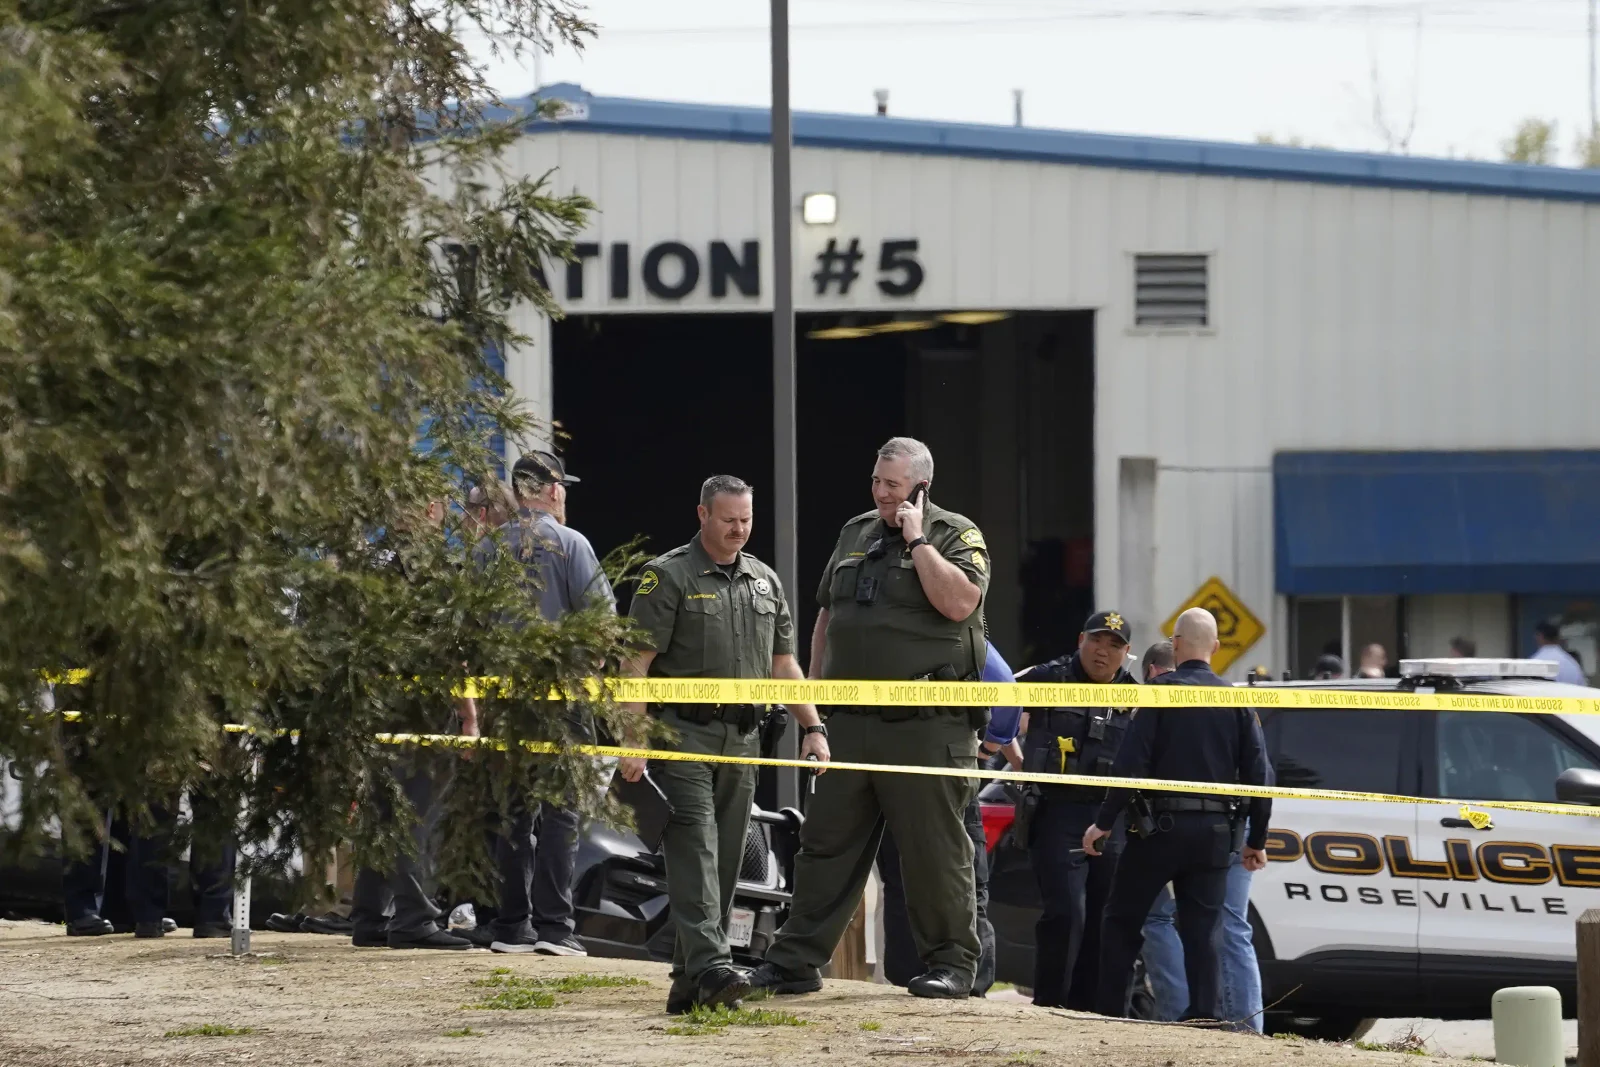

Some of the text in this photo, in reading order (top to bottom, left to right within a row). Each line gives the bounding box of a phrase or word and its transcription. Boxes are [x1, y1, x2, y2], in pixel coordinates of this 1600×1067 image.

[442, 237, 924, 300] TATION #5
[1266, 828, 1600, 887] POLICE
[1284, 882, 1569, 915] ROSEVILLE
